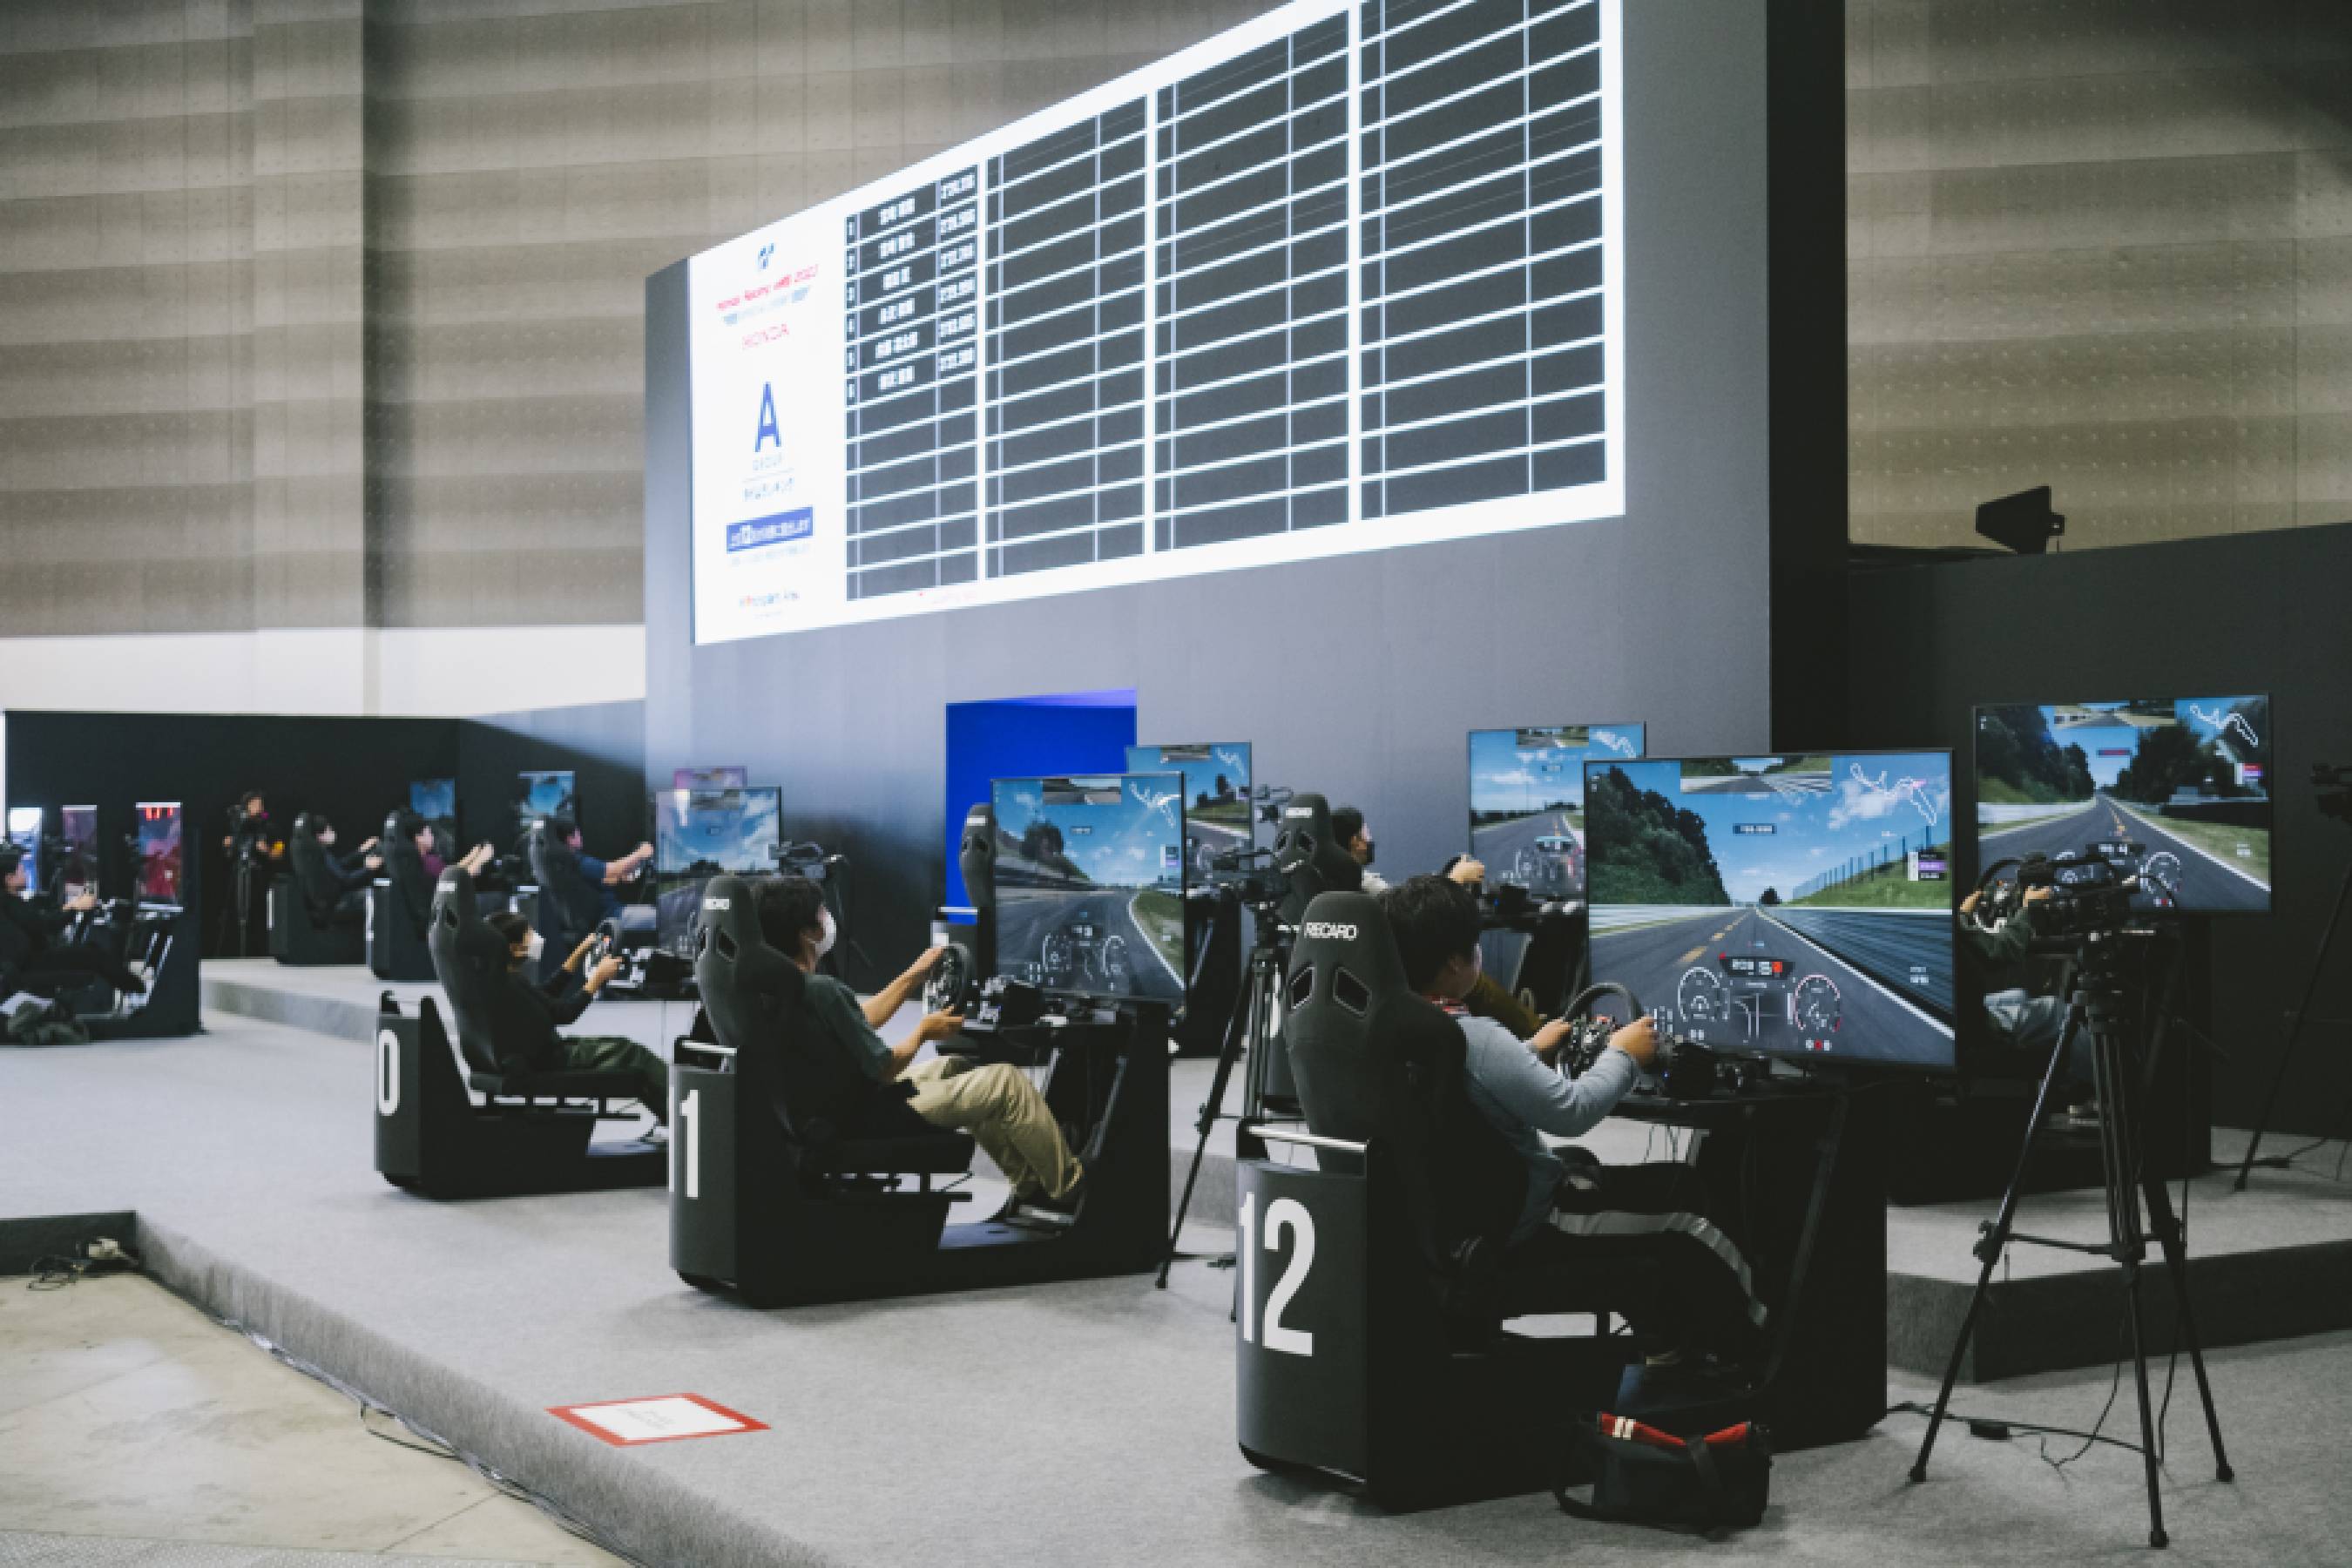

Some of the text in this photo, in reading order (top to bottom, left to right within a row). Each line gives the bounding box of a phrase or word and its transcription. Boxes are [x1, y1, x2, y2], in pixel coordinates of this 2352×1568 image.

[754, 381, 781, 453] A
[1304, 922, 1357, 941] RECARO
[1238, 1191, 1315, 1357] 12
